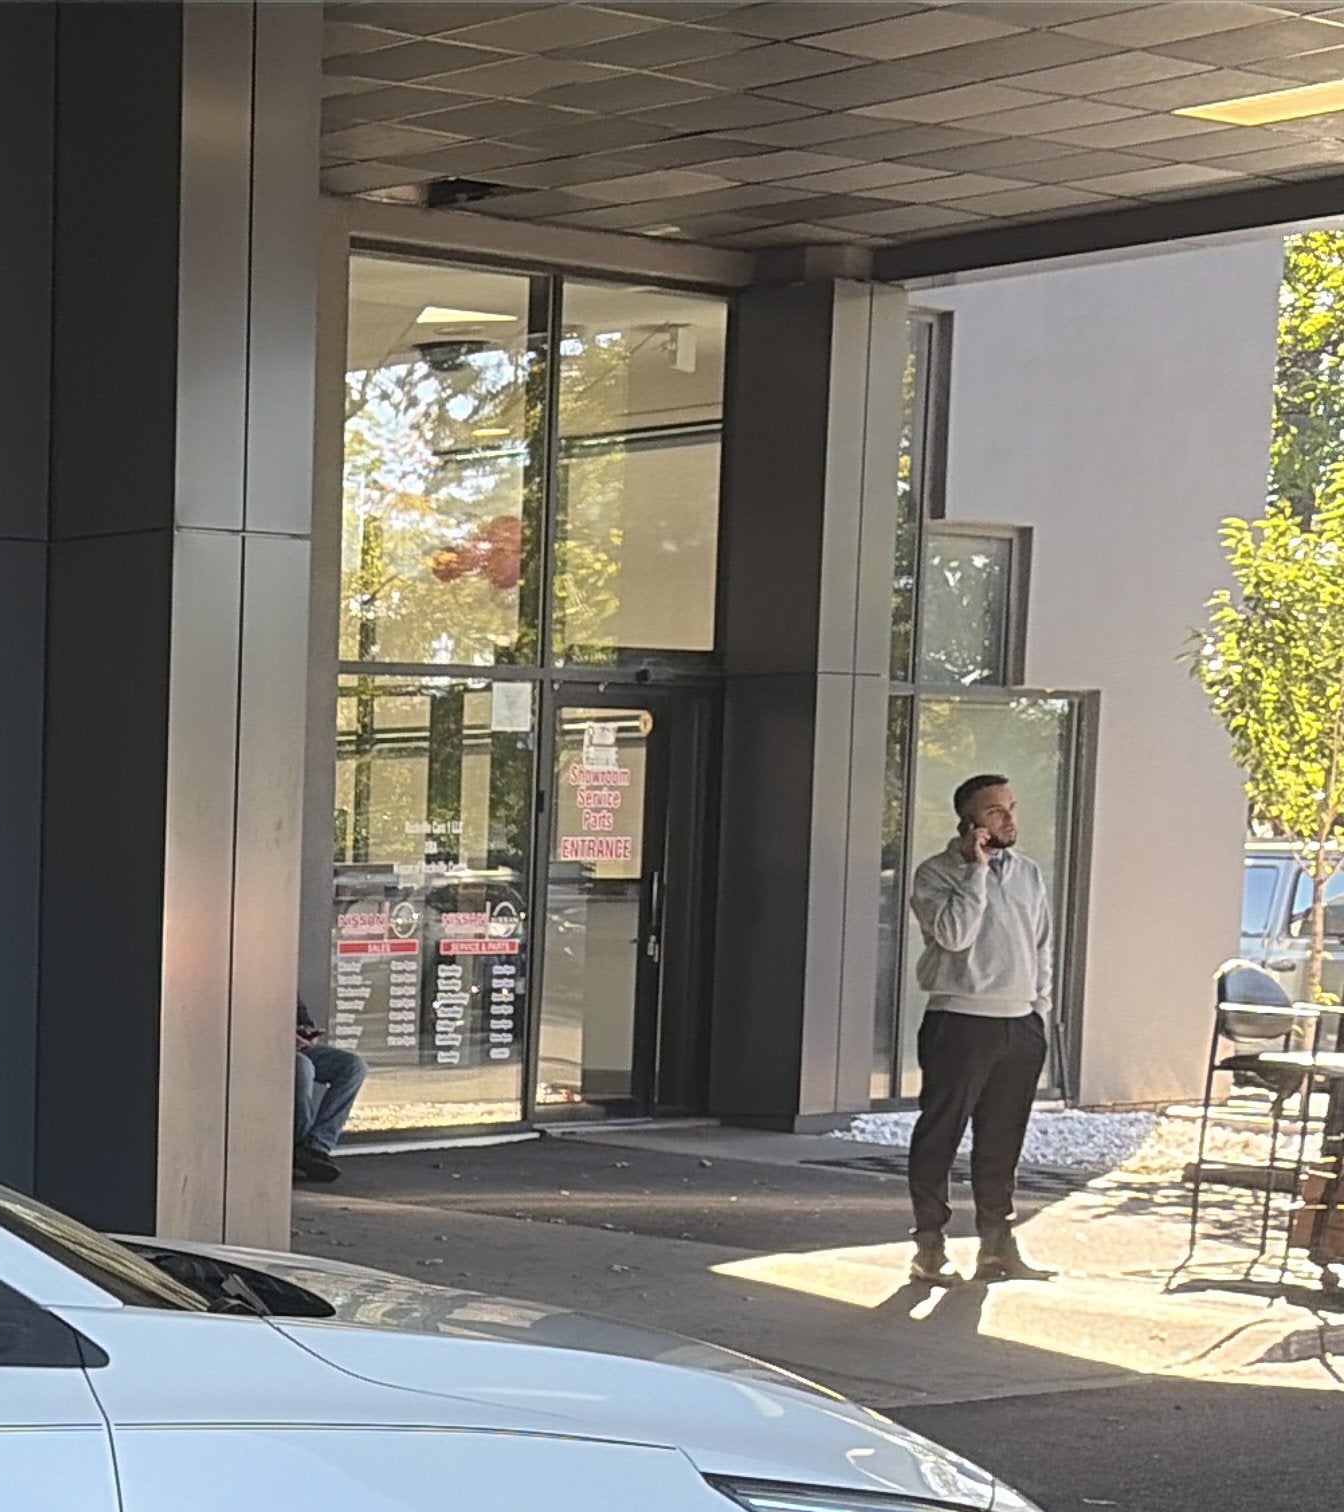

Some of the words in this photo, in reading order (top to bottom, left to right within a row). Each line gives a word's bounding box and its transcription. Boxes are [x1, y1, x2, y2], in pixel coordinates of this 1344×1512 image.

[570, 763, 631, 785] Showroom
[577, 787, 621, 808] Service
[583, 809, 613, 830] Parts
[561, 837, 631, 861] ENTRANCE
